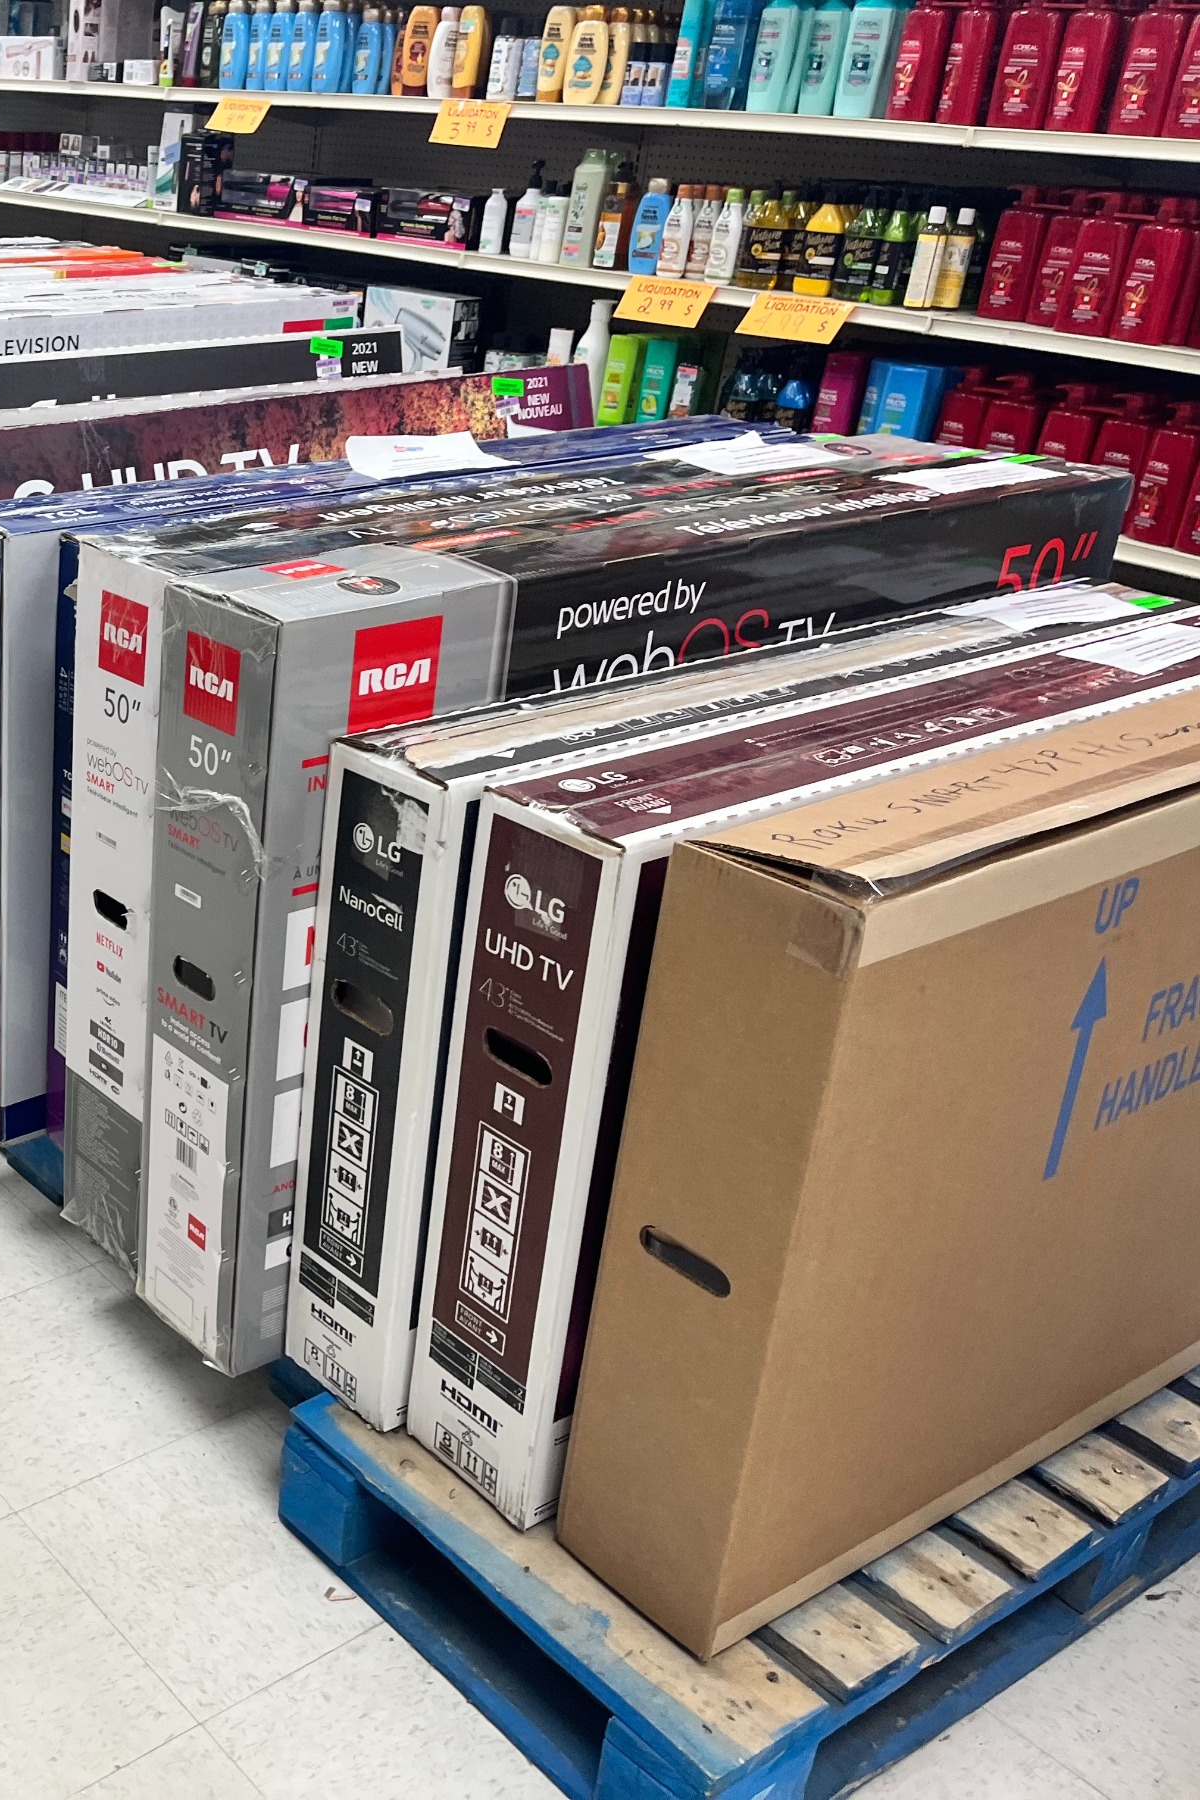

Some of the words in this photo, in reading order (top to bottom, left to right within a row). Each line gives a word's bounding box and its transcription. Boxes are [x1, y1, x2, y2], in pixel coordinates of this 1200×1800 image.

[223, 102, 263, 112] LIQUIDATION
[447, 107, 500, 119] LIQUIDATION
[637, 283, 702, 299] LIQUIDATION
[764, 301, 838, 316] LIQUIDATION
[352, 342, 377, 355] 2021
[352, 360, 378, 374] NEW
[527, 377, 548, 389] 2021
[527, 393, 550, 406] NEW
[518, 403, 562, 420] NOUVEAU
[37, 508, 97, 519] TCL
[675, 501, 831, 537] Téléviseur
[997, 531, 1098, 593] 50"
[557, 581, 671, 639] powered
[674, 578, 707, 614] by
[104, 621, 143, 655] RCA
[189, 665, 234, 702] RCA
[358, 657, 432, 696] RCA
[104, 687, 141, 724] 50"
[87, 738, 110, 755] powered
[109, 749, 117, 758] by
[189, 734, 231, 775] 50"
[86, 771, 115, 795] SMART
[135, 776, 149, 795] TV
[586, 771, 628, 785] LG
[614, 793, 657, 808] FRONT
[167, 823, 201, 849] SMART
[223, 832, 238, 852] TV
[377, 835, 401, 863] LG
[340, 885, 404, 932] NanoCell
[534, 890, 566, 923] LG
[1095, 877, 1140, 935] UP
[96, 932, 123, 959] NETFLIX
[485, 929, 533, 971] UHD
[540, 954, 573, 991] TV
[156, 986, 206, 1032] SMART
[209, 1020, 229, 1044] TV
[97, 1028, 118, 1049] HDR10
[190, 1030, 211, 1049] access
[346, 1084, 355, 1101] 8
[493, 1142, 503, 1160] 8
[491, 1159, 506, 1175] MAX
[189, 1222, 206, 1241] RCA
[322, 1232, 343, 1252] FRONT
[322, 1241, 343, 1260] AVANT
[311, 1303, 356, 1344] HDMI
[459, 1315, 482, 1335] AVANT
[460, 1307, 482, 1328] FRONT
[441, 1379, 502, 1434] HDMI
